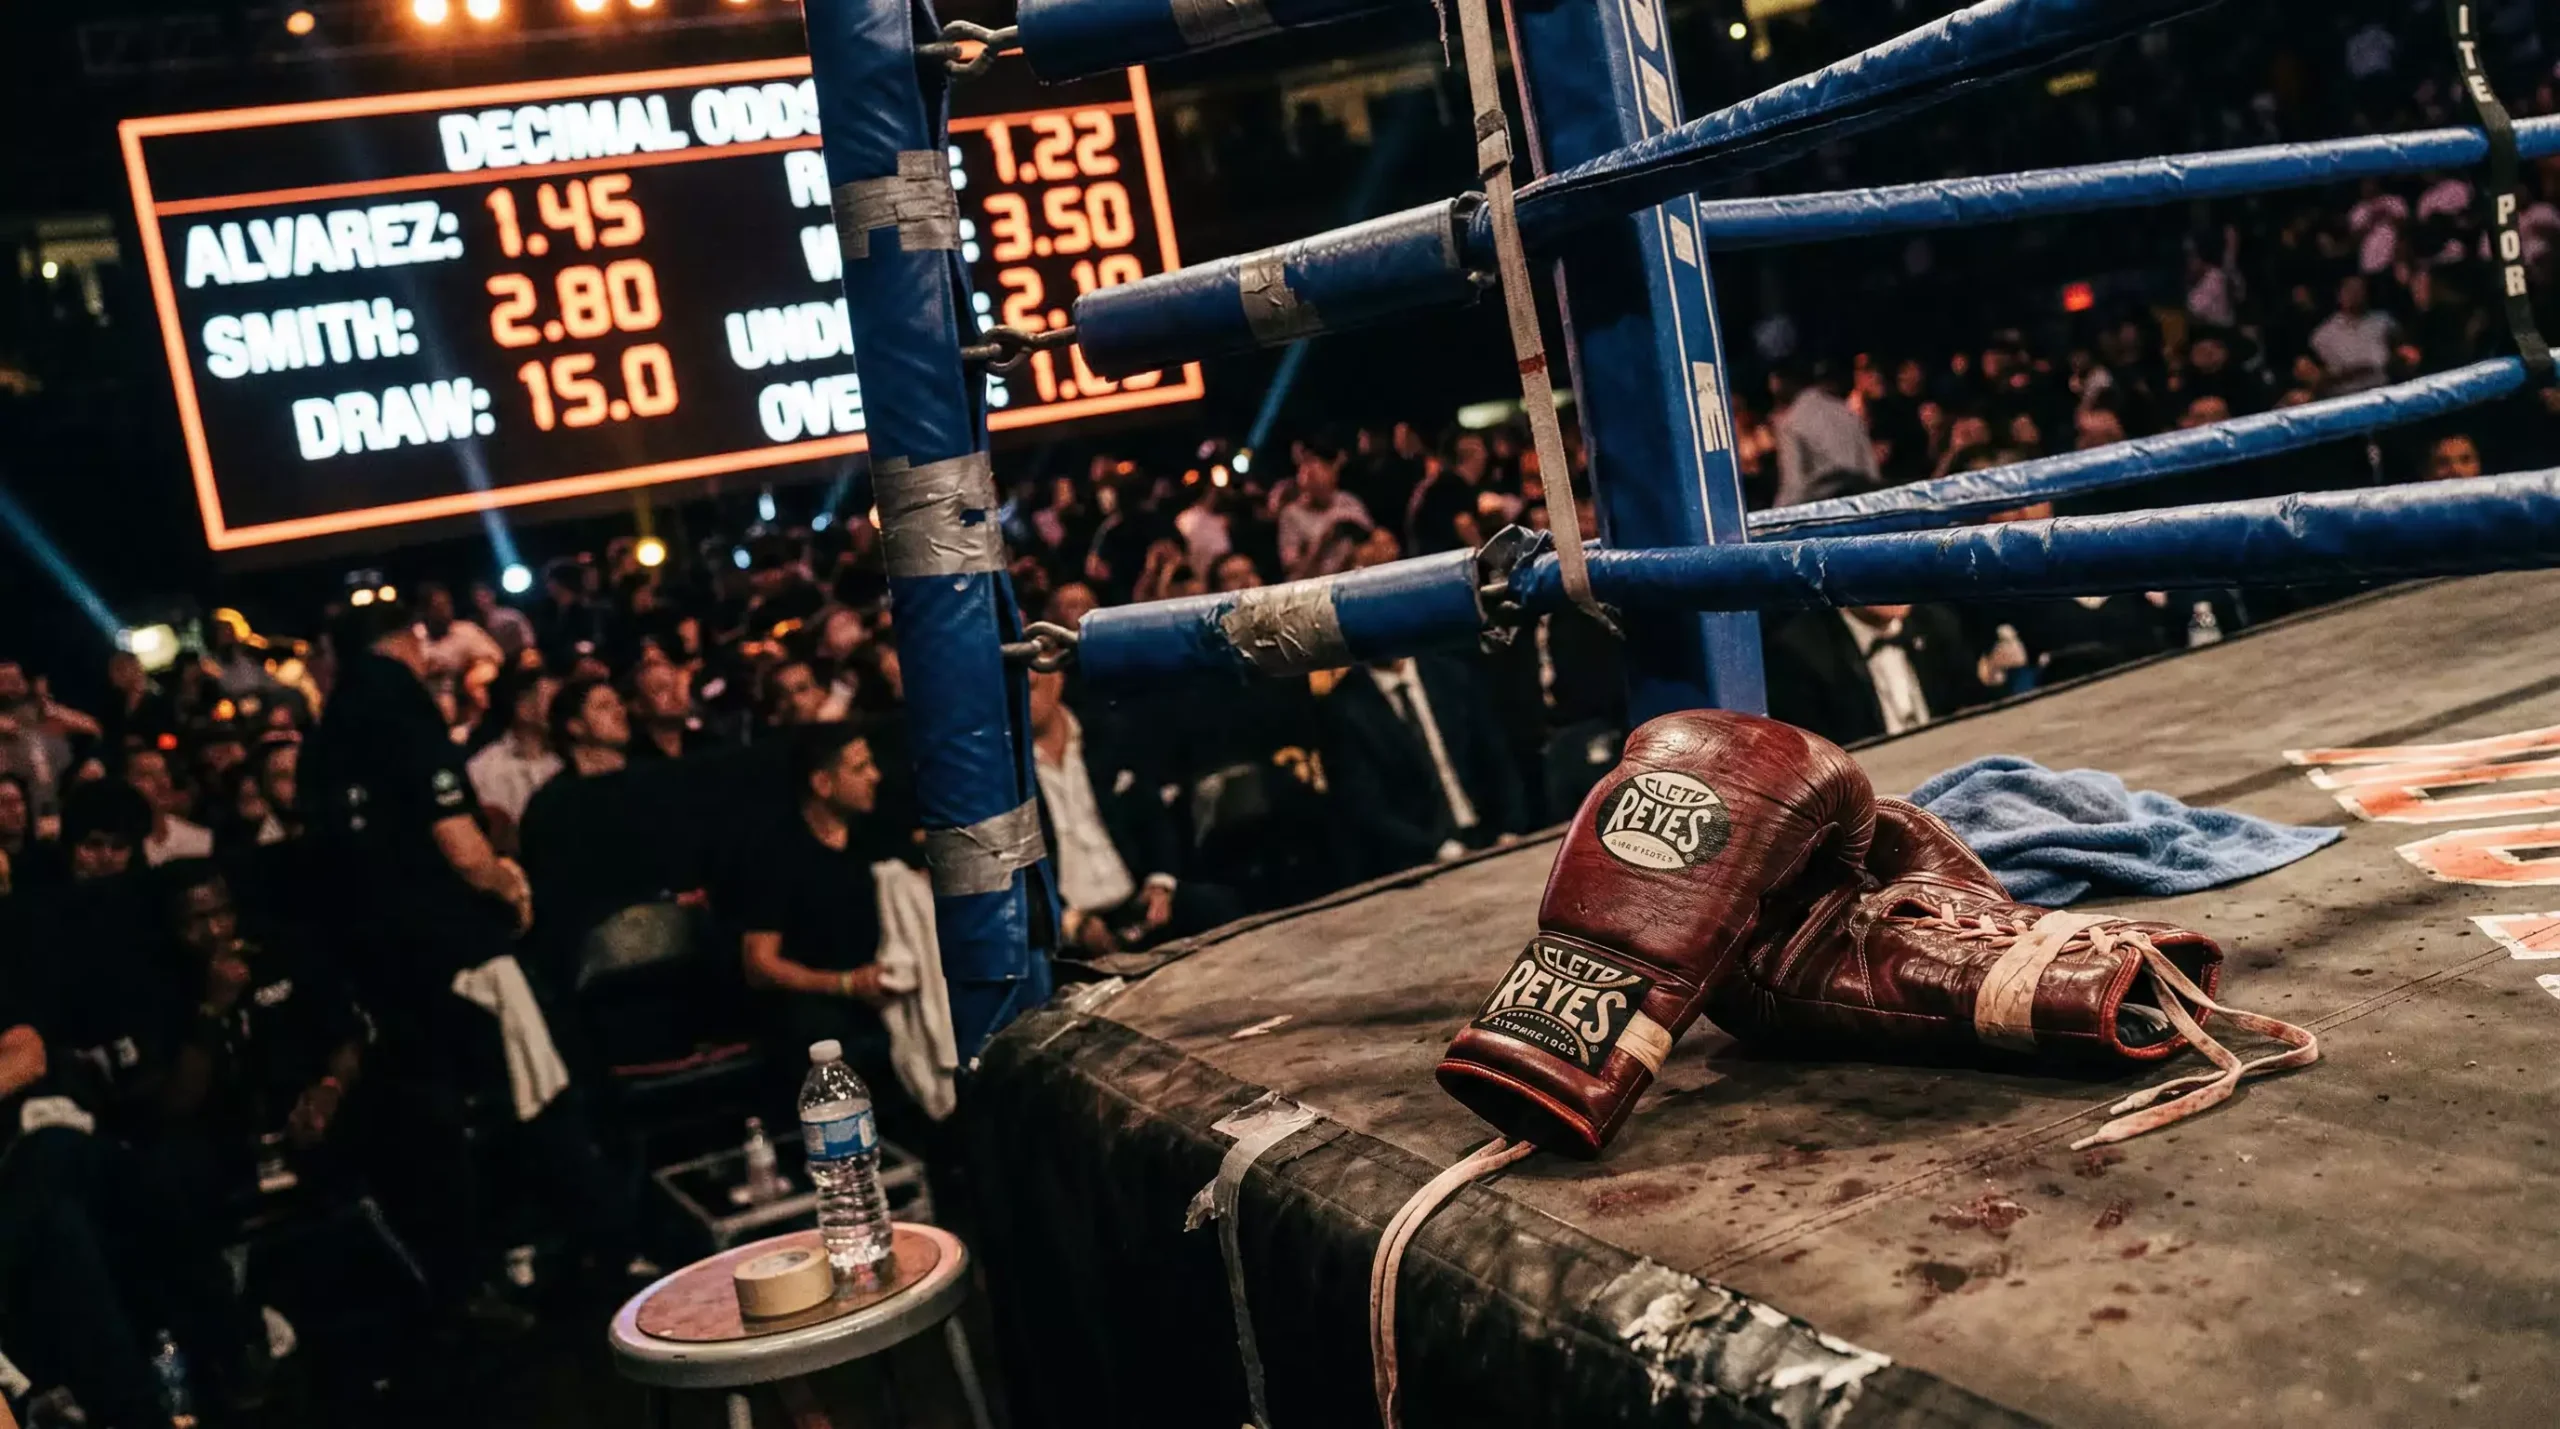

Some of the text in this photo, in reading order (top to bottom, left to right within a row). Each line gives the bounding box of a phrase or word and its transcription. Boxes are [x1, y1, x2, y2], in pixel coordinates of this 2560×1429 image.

[438, 94, 690, 173] DECIMAL
[983, 107, 1121, 185] 1.22
[185, 172, 646, 289] ALVAREZ: 1.45
[982, 179, 1135, 263] 3.50
[202, 257, 663, 379] SMITH: 2.80
[291, 342, 680, 461] DRAW: 15.0
[1602, 787, 1712, 853] REYES
[1486, 959, 1628, 1044] REYES
